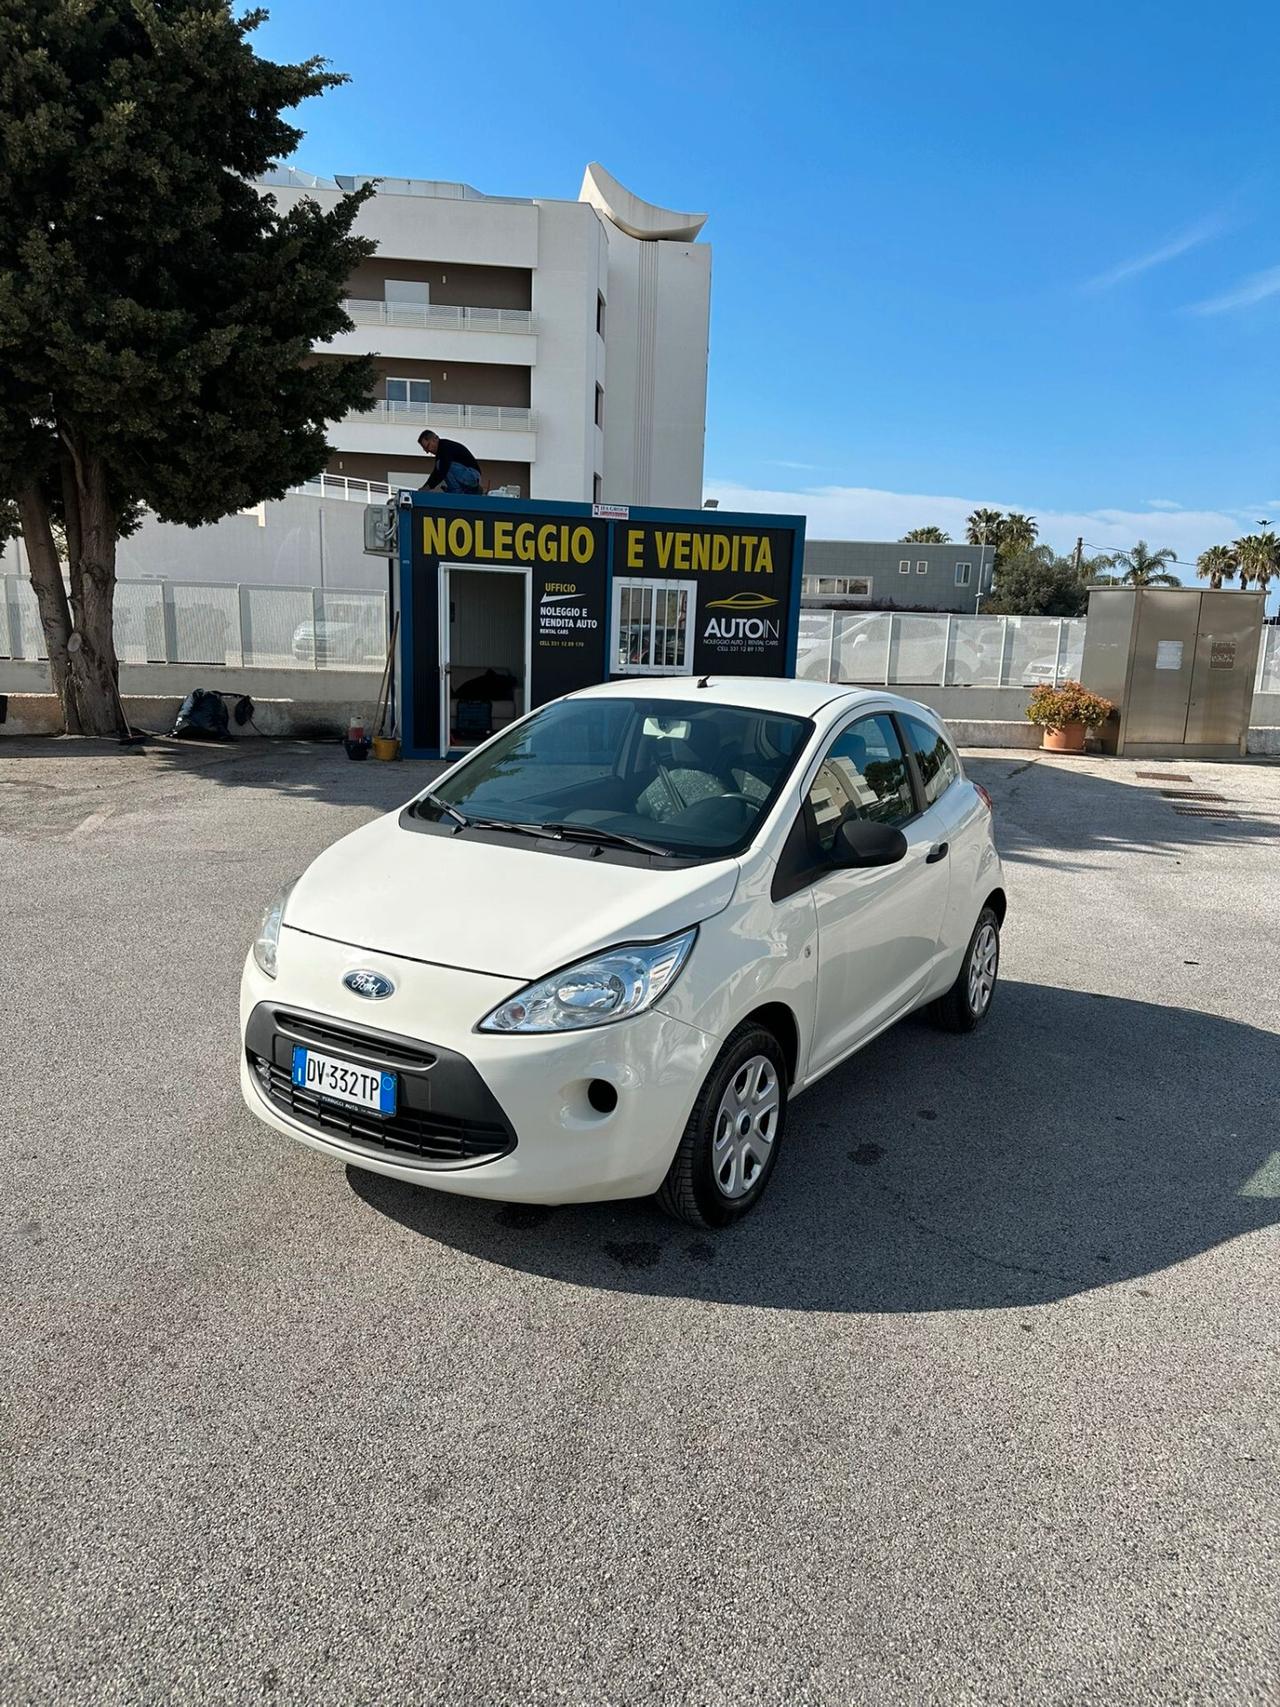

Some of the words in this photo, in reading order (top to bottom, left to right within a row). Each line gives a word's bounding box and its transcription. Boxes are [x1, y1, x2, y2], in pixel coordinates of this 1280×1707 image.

[422, 516, 595, 564] NOLEGGIO
[627, 530, 645, 568] E
[654, 531, 774, 574] VENDITA
[545, 582, 576, 592] UFFICIO
[540, 606, 580, 616] NOLEGGIO
[582, 608, 588, 617] E
[540, 618, 574, 628] VENDITA
[576, 619, 598, 629] AUTO
[351, 972, 380, 992] Ford
